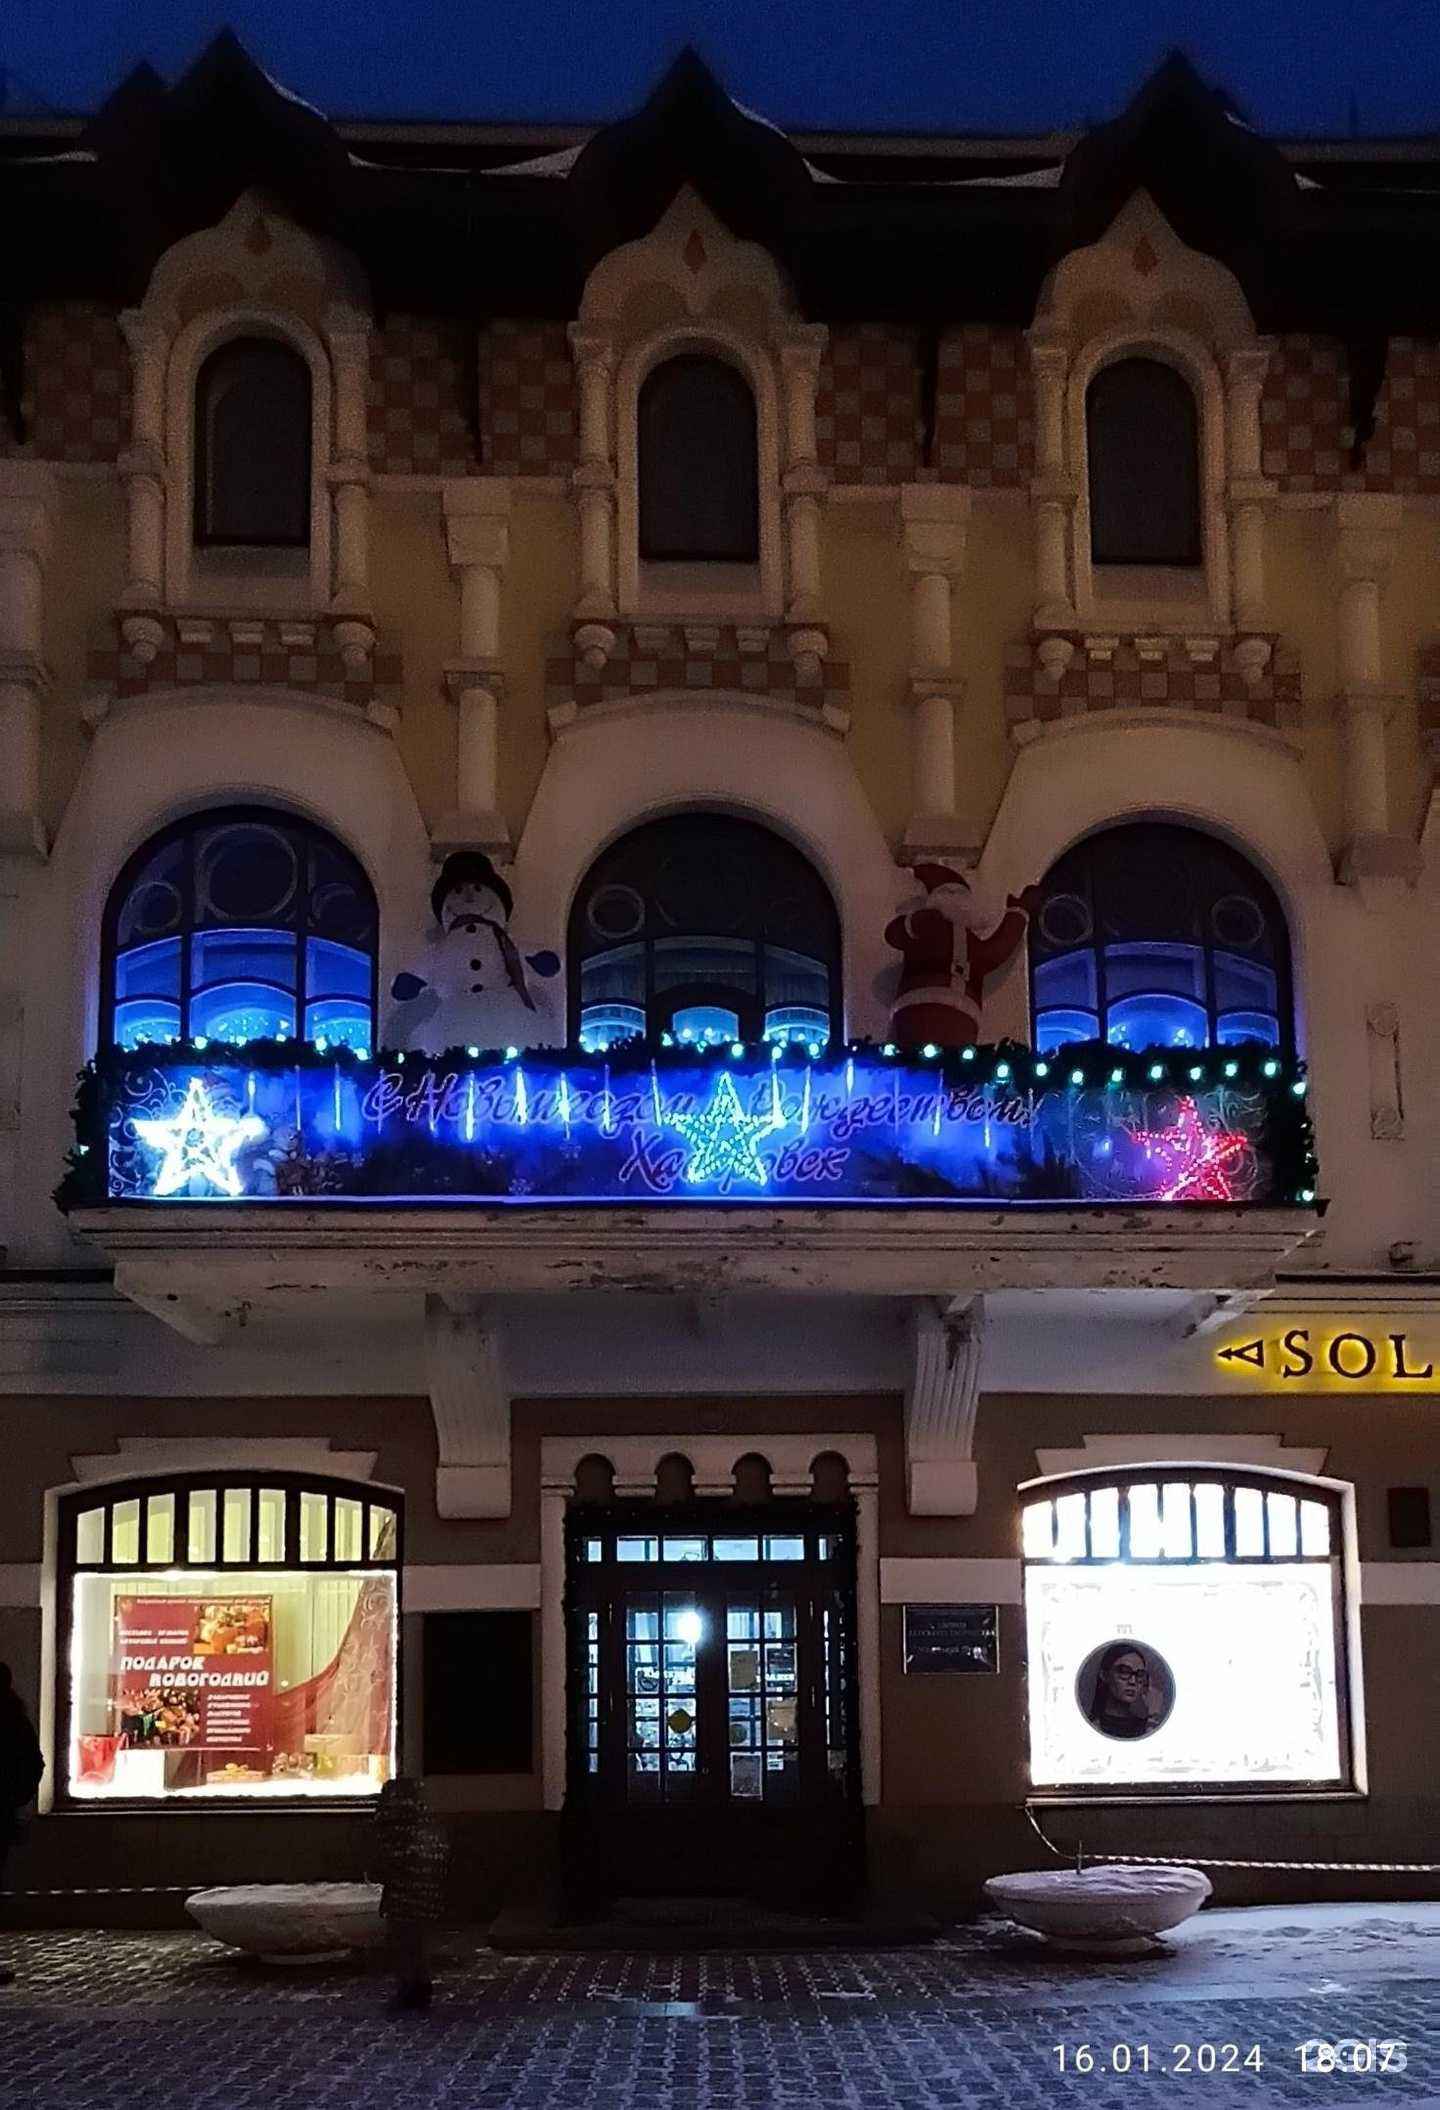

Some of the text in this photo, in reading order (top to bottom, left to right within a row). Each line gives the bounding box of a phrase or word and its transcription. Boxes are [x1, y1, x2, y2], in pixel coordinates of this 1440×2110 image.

[1283, 1329, 1433, 1378] SOL
[120, 1655, 206, 1671] ПОДАРОК
[149, 1670, 270, 1687] НОВОГОДНИЙ
